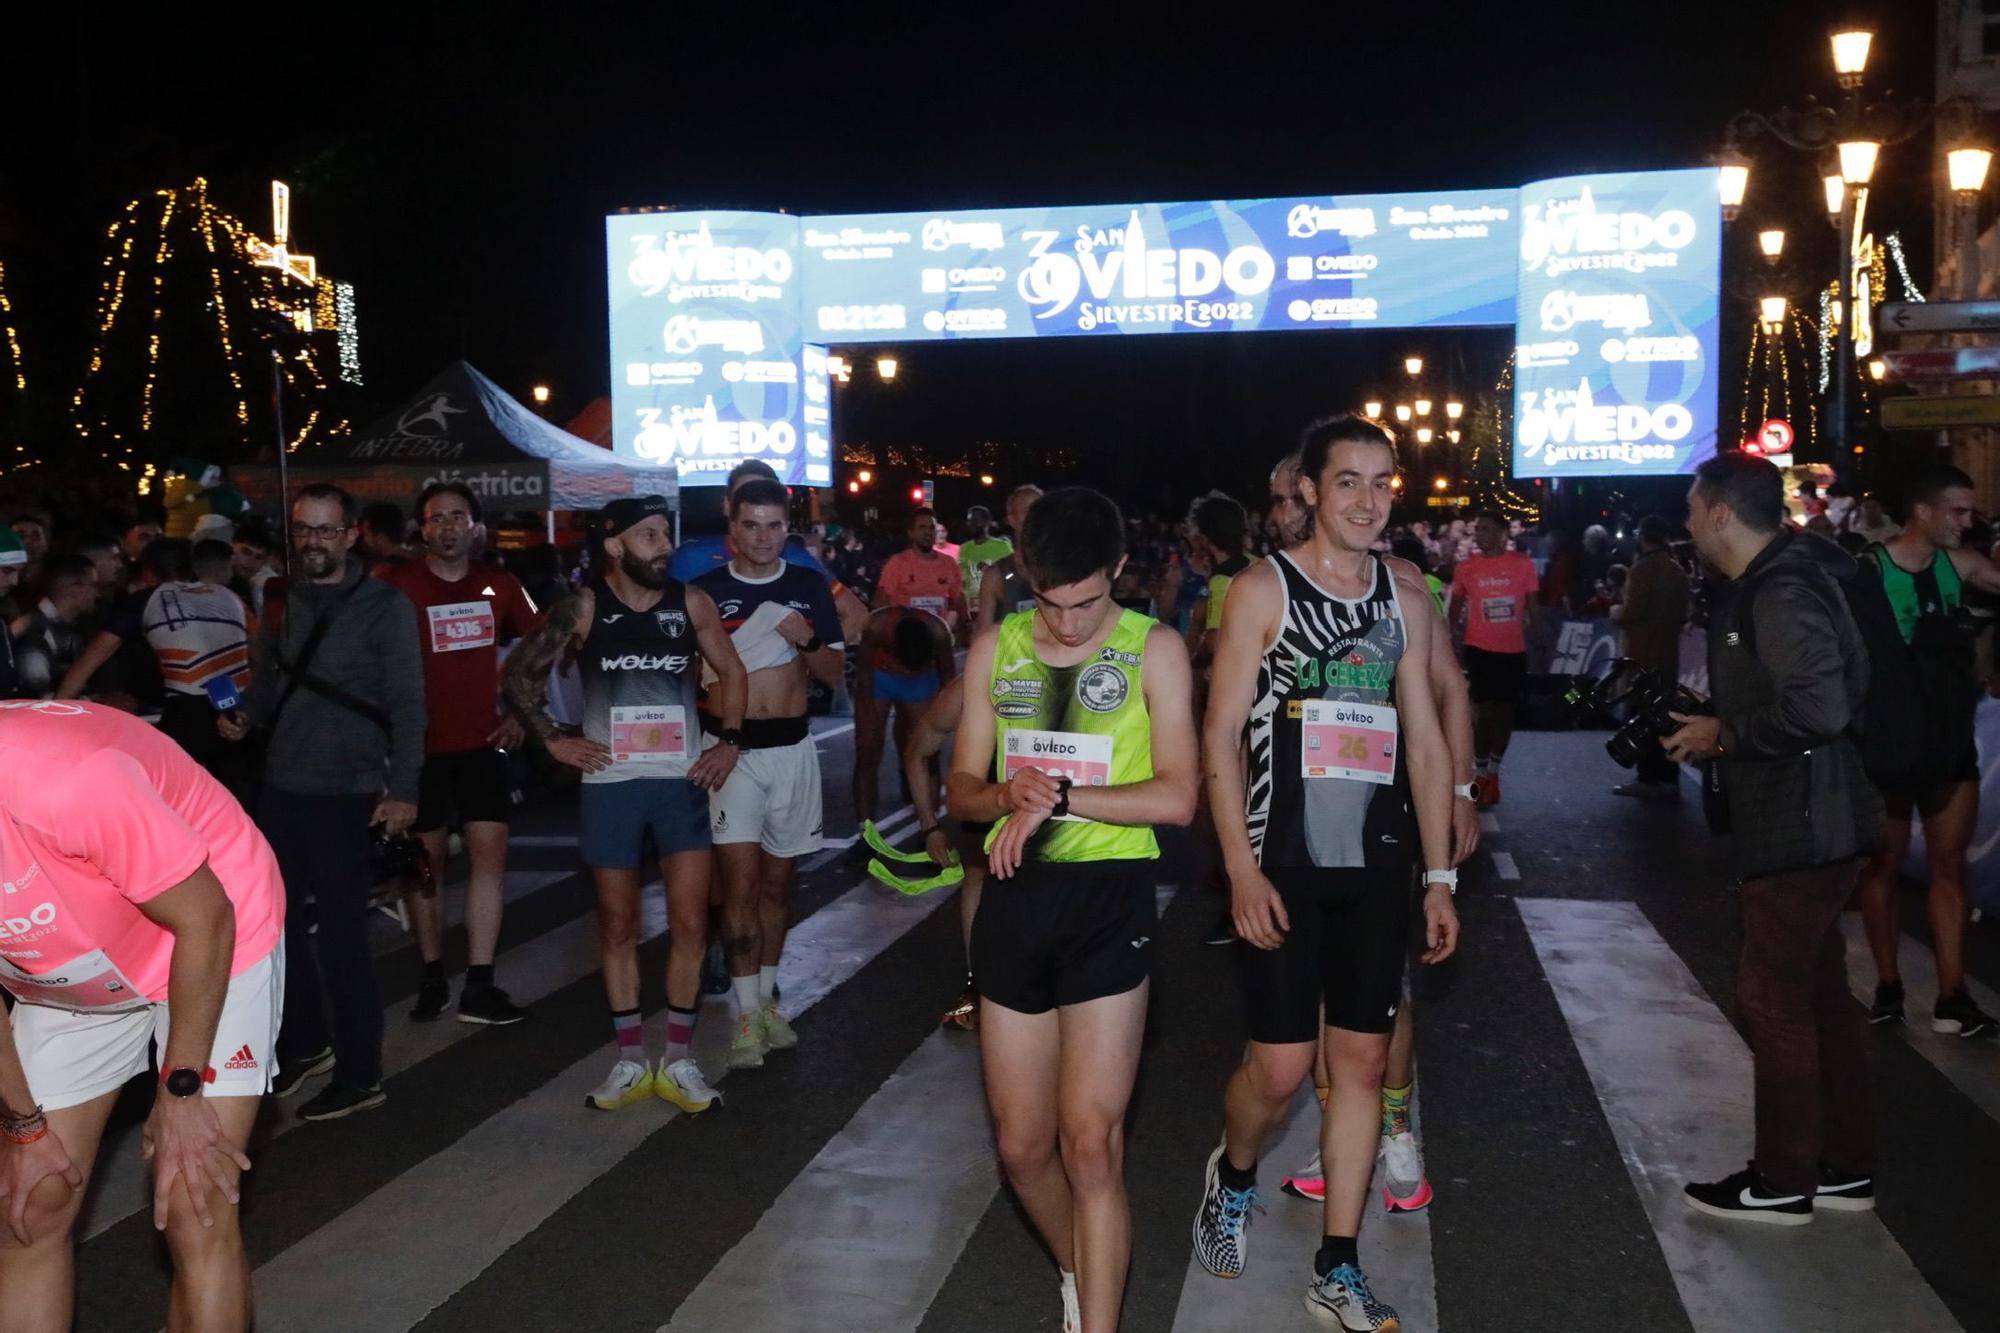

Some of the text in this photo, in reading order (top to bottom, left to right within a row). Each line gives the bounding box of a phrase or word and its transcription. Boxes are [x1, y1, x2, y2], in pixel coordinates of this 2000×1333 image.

[349, 438, 464, 458] INTEGRA
[1328, 637, 1384, 657] RESTAURANTE
[600, 654, 689, 674] WOLVES
[1295, 654, 1320, 689] LA
[1033, 738, 1076, 754] OVIEDO
[1338, 733, 1369, 761] 26
[224, 1060, 258, 1069] adidas
